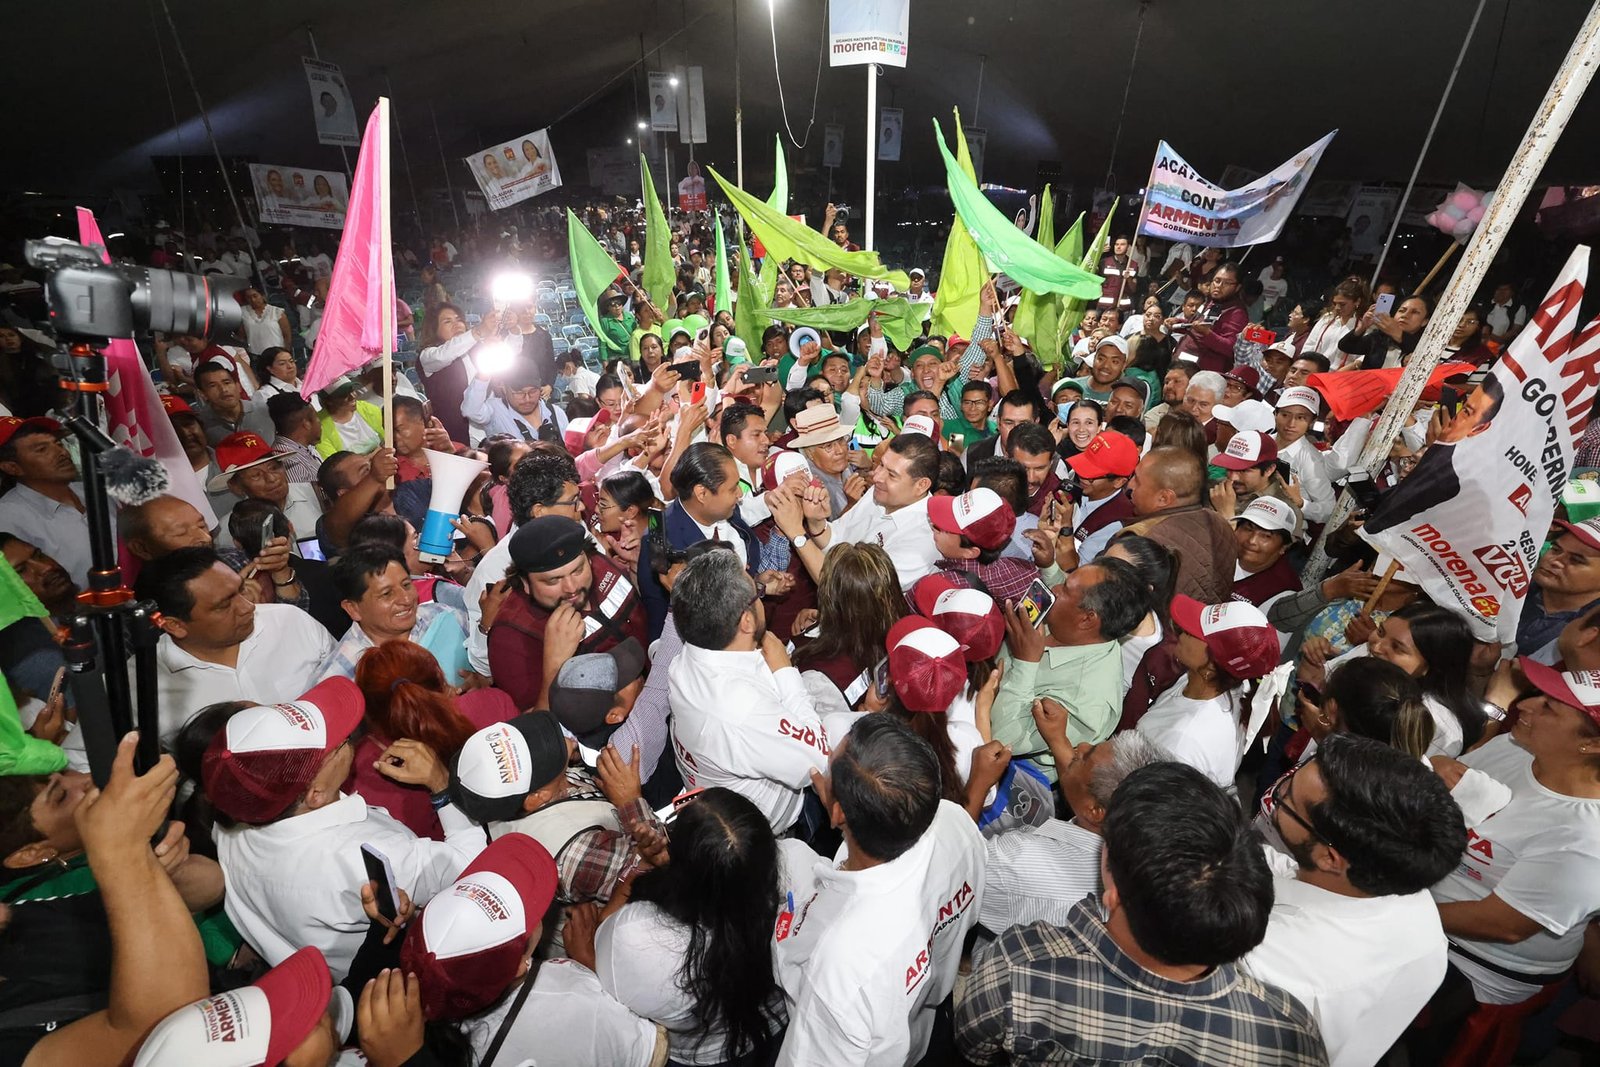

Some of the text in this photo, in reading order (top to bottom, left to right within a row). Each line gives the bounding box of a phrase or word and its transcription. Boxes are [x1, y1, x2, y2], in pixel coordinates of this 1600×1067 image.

[833, 41, 878, 54] morena
[1181, 189, 1217, 211] CON
[1149, 203, 1241, 231] ARMENTA
[1162, 222, 1218, 238] GOBERNADOR
[245, 439, 257, 448] PT
[1411, 523, 1487, 596] morena
[1474, 597, 1495, 616] PT
[489, 740, 513, 785] AVANCE
[455, 884, 508, 921] ARMENTA
[474, 896, 498, 921] morena
